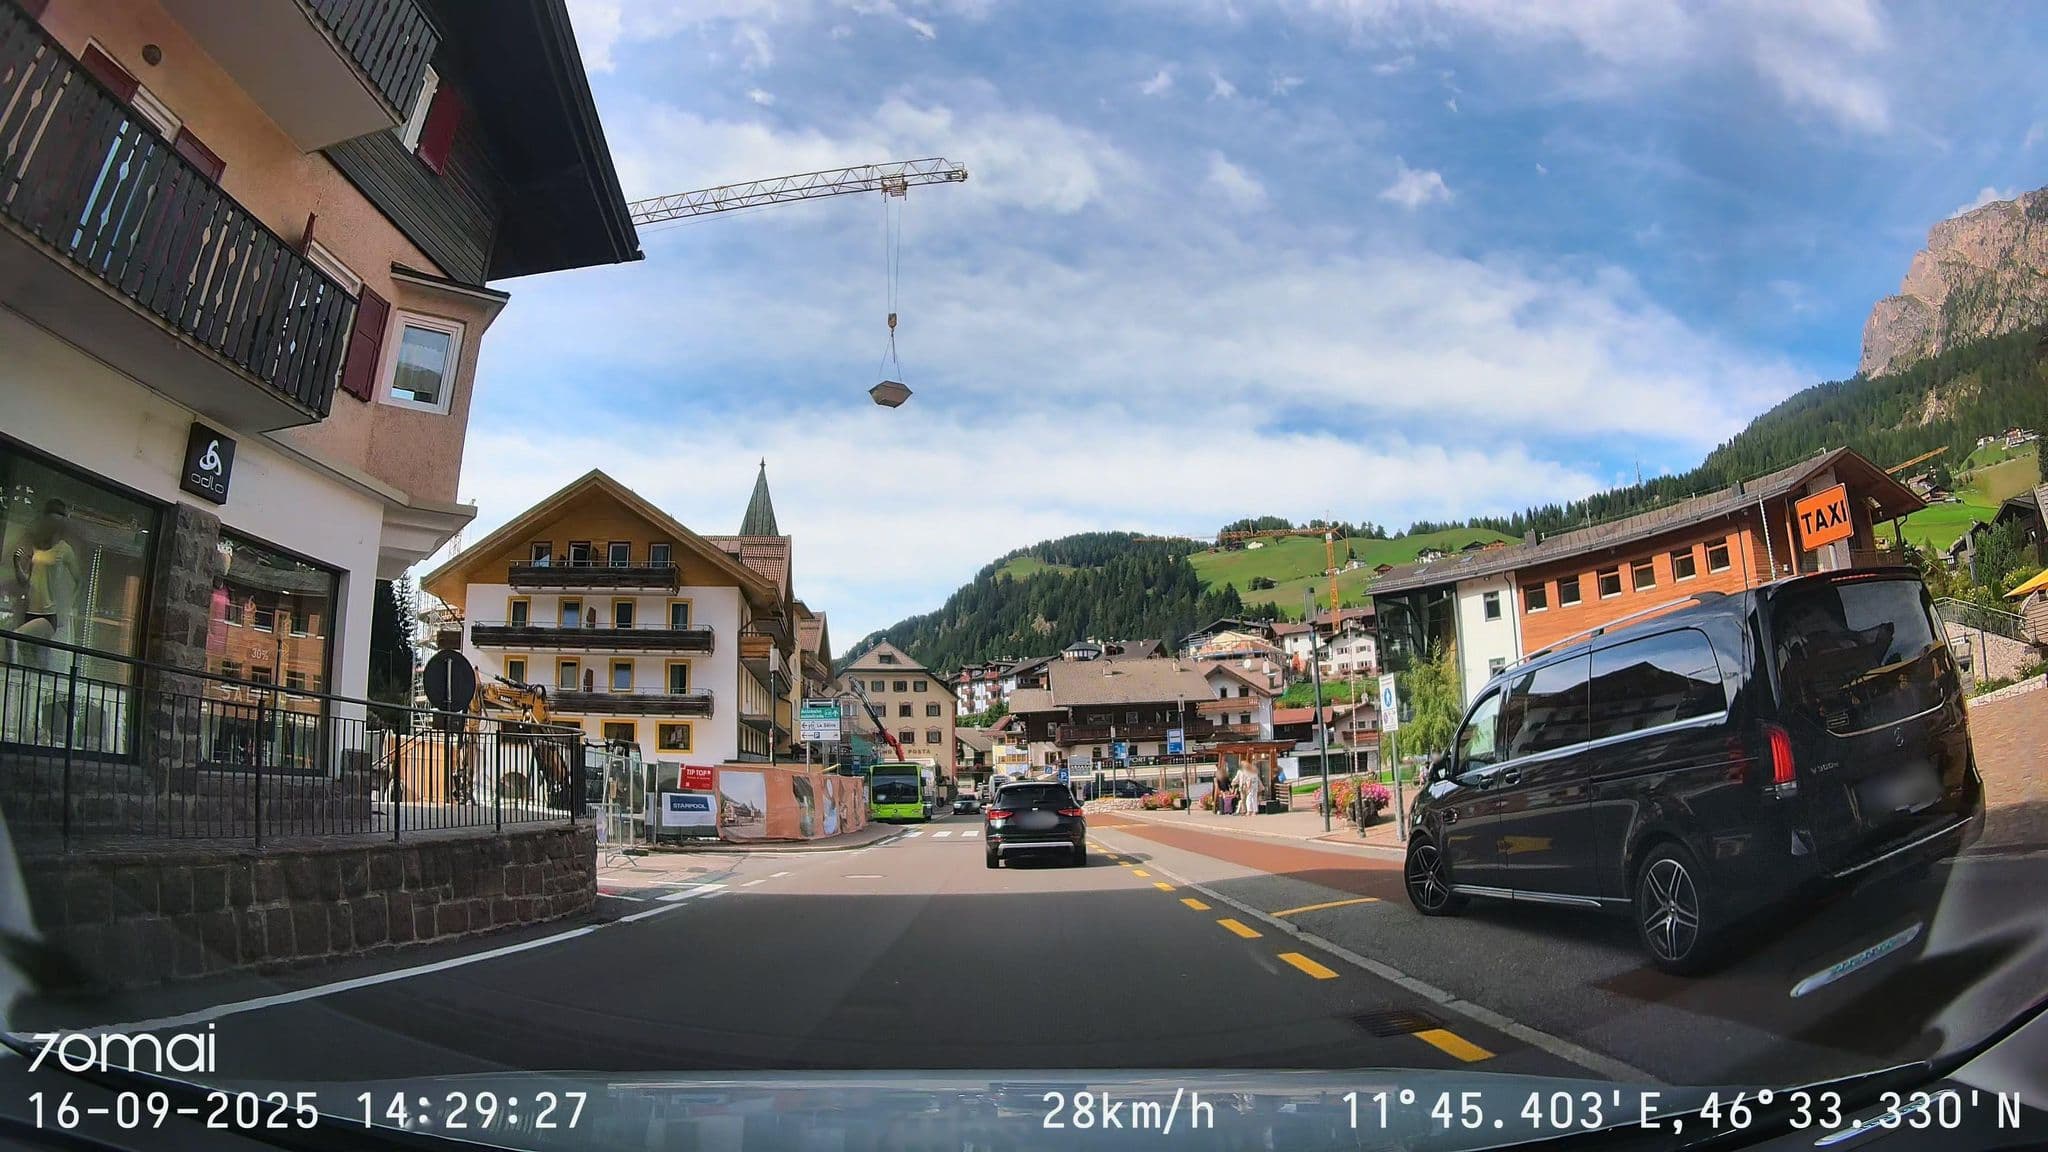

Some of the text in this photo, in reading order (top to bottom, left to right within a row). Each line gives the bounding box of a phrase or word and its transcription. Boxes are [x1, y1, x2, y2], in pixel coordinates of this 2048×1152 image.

[191, 474, 225, 494] odlo
[1800, 500, 1848, 535] TAXI
[251, 647, 270, 661] 30%
